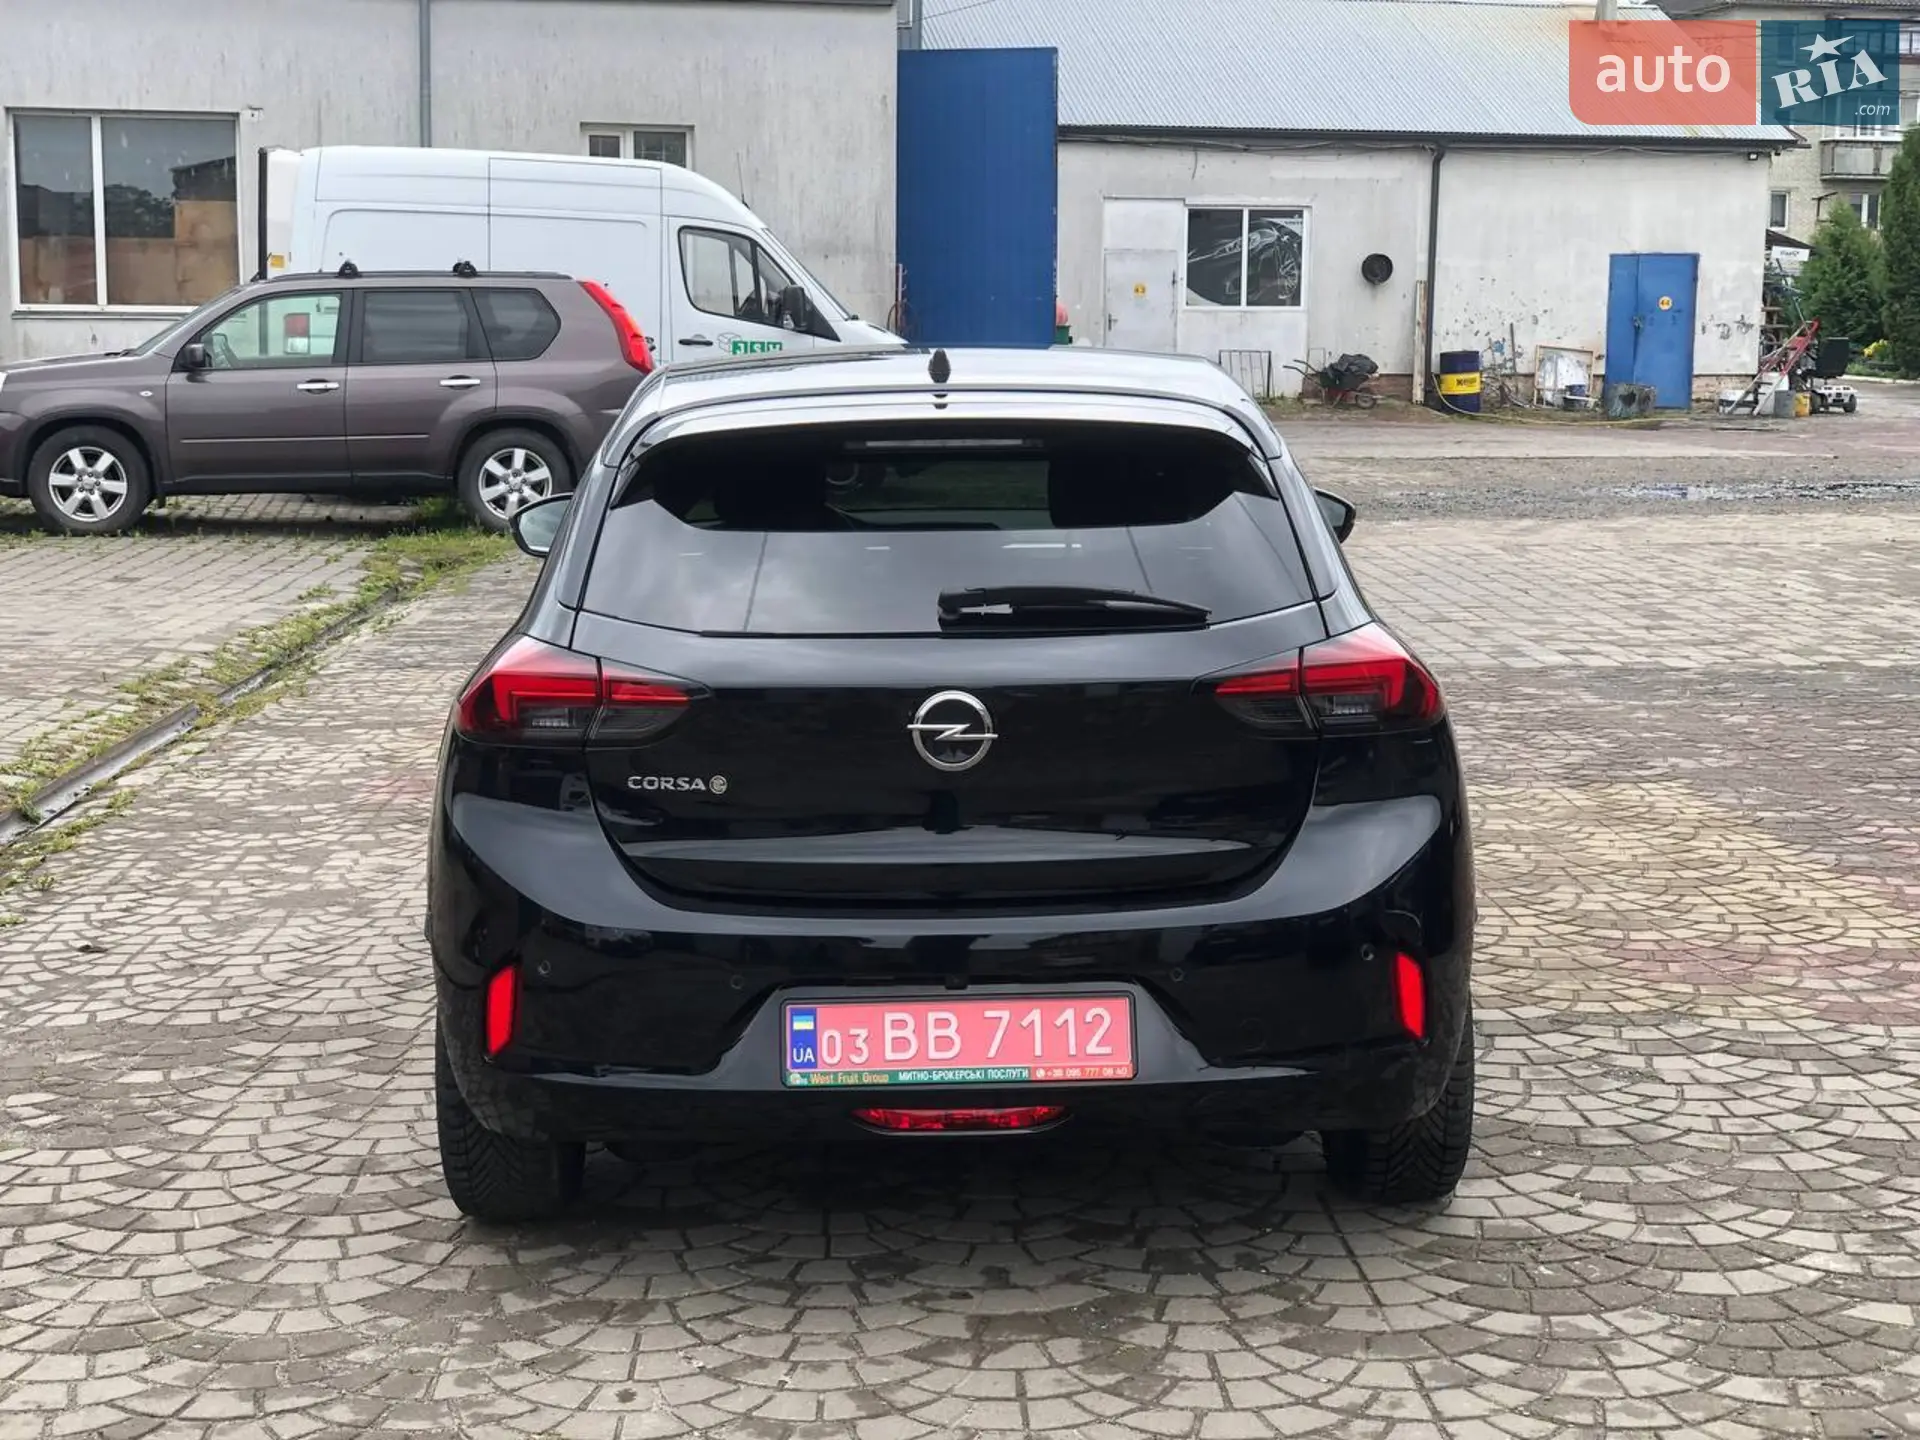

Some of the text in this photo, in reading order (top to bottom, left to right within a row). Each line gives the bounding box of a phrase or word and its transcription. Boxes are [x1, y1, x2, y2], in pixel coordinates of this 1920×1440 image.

[627, 776, 706, 791] CORSA
[821, 1007, 1113, 1065] 03 BB 7112
[793, 1047, 815, 1063] UA
[987, 1068, 1028, 1080] ПОСЛУГИ
